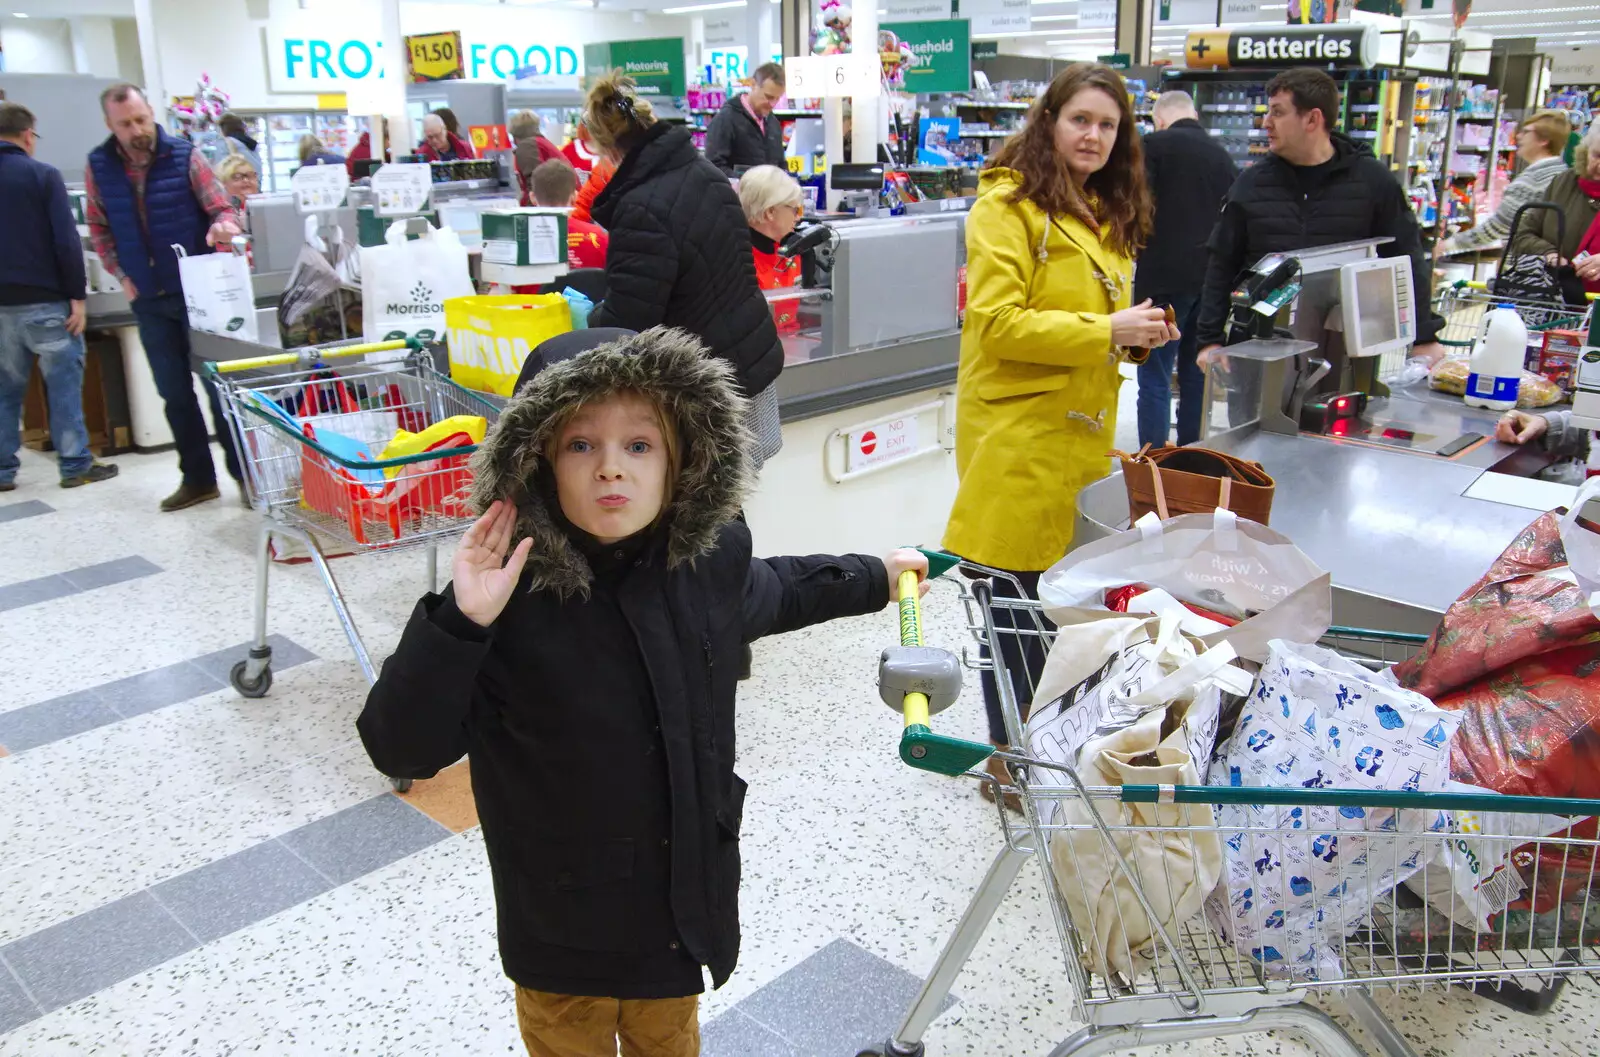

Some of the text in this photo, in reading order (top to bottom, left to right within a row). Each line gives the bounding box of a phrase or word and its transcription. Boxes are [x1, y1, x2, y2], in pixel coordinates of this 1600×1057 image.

[1228, 3, 1257, 12] bleach
[414, 40, 453, 62] £1.50
[1237, 34, 1352, 60] Batteries
[284, 38, 578, 79] FRO FOOD
[626, 60, 669, 74] Motoring
[835, 66, 845, 85] 6
[931, 122, 950, 133] New
[888, 420, 904, 432] NO
[886, 435, 906, 449] EXIT
[899, 596, 919, 647] MORRISON
[1456, 837, 1481, 875] ons
